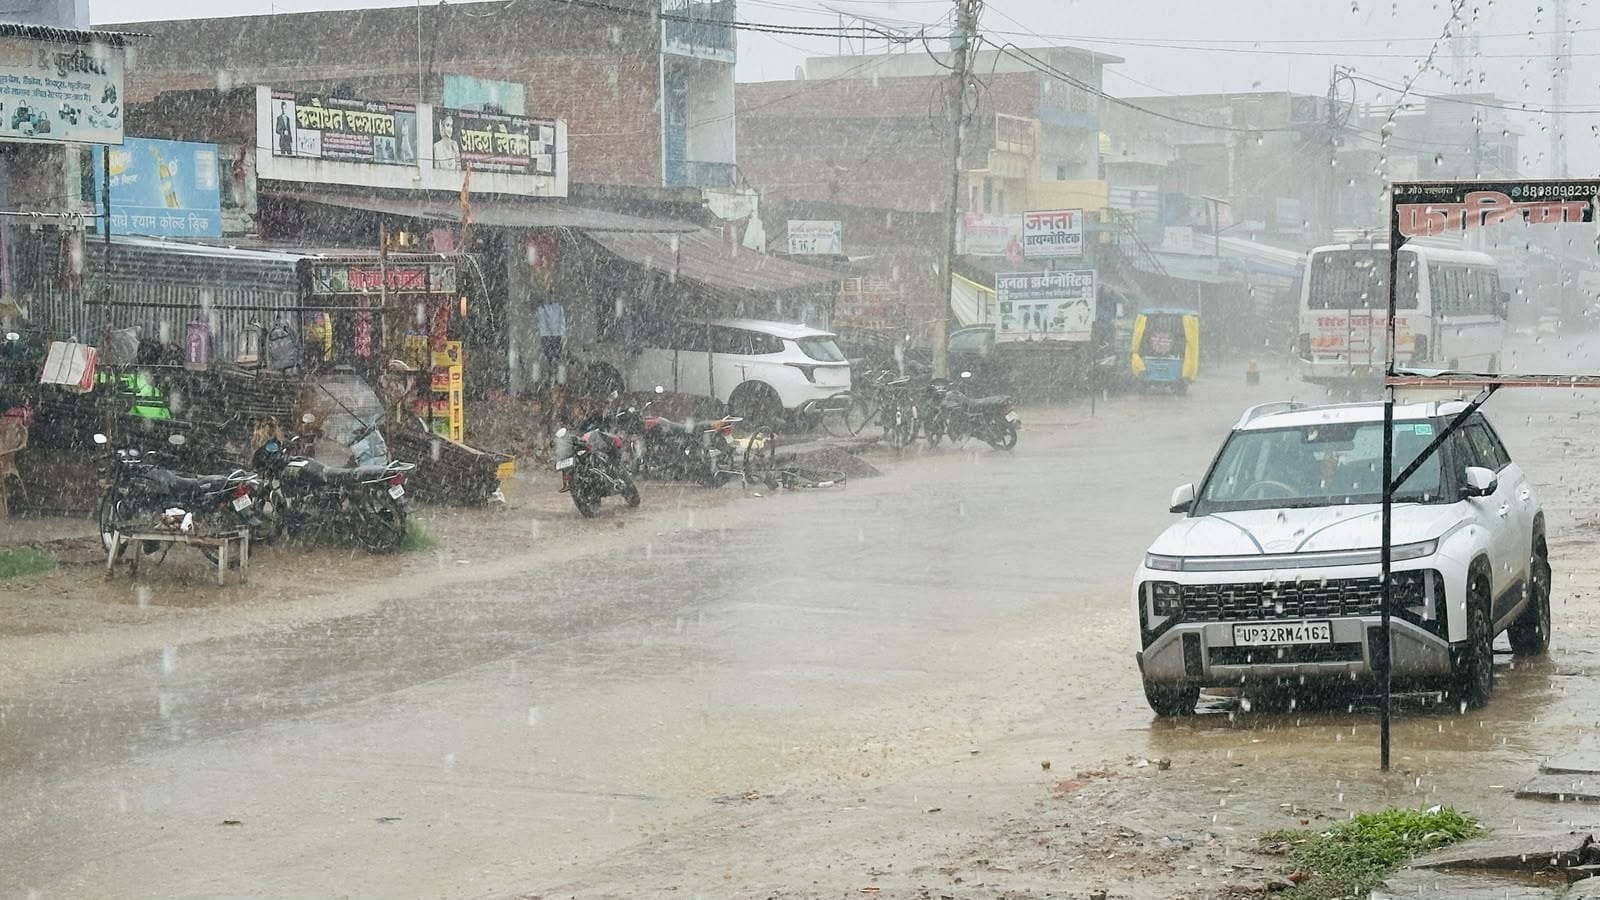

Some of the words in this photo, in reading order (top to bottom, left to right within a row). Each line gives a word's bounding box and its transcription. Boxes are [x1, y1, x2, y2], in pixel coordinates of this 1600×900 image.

[38, 48, 50, 70] &
[461, 124, 493, 153] आदर्श
[131, 214, 156, 229] श्याम
[160, 211, 185, 230] कोल्ड
[1025, 212, 1073, 231] जनता
[1025, 232, 1081, 246] डायग्नोस्टिक
[999, 276, 1029, 289] जनता
[1243, 625, 1329, 642] UP32RM4162
